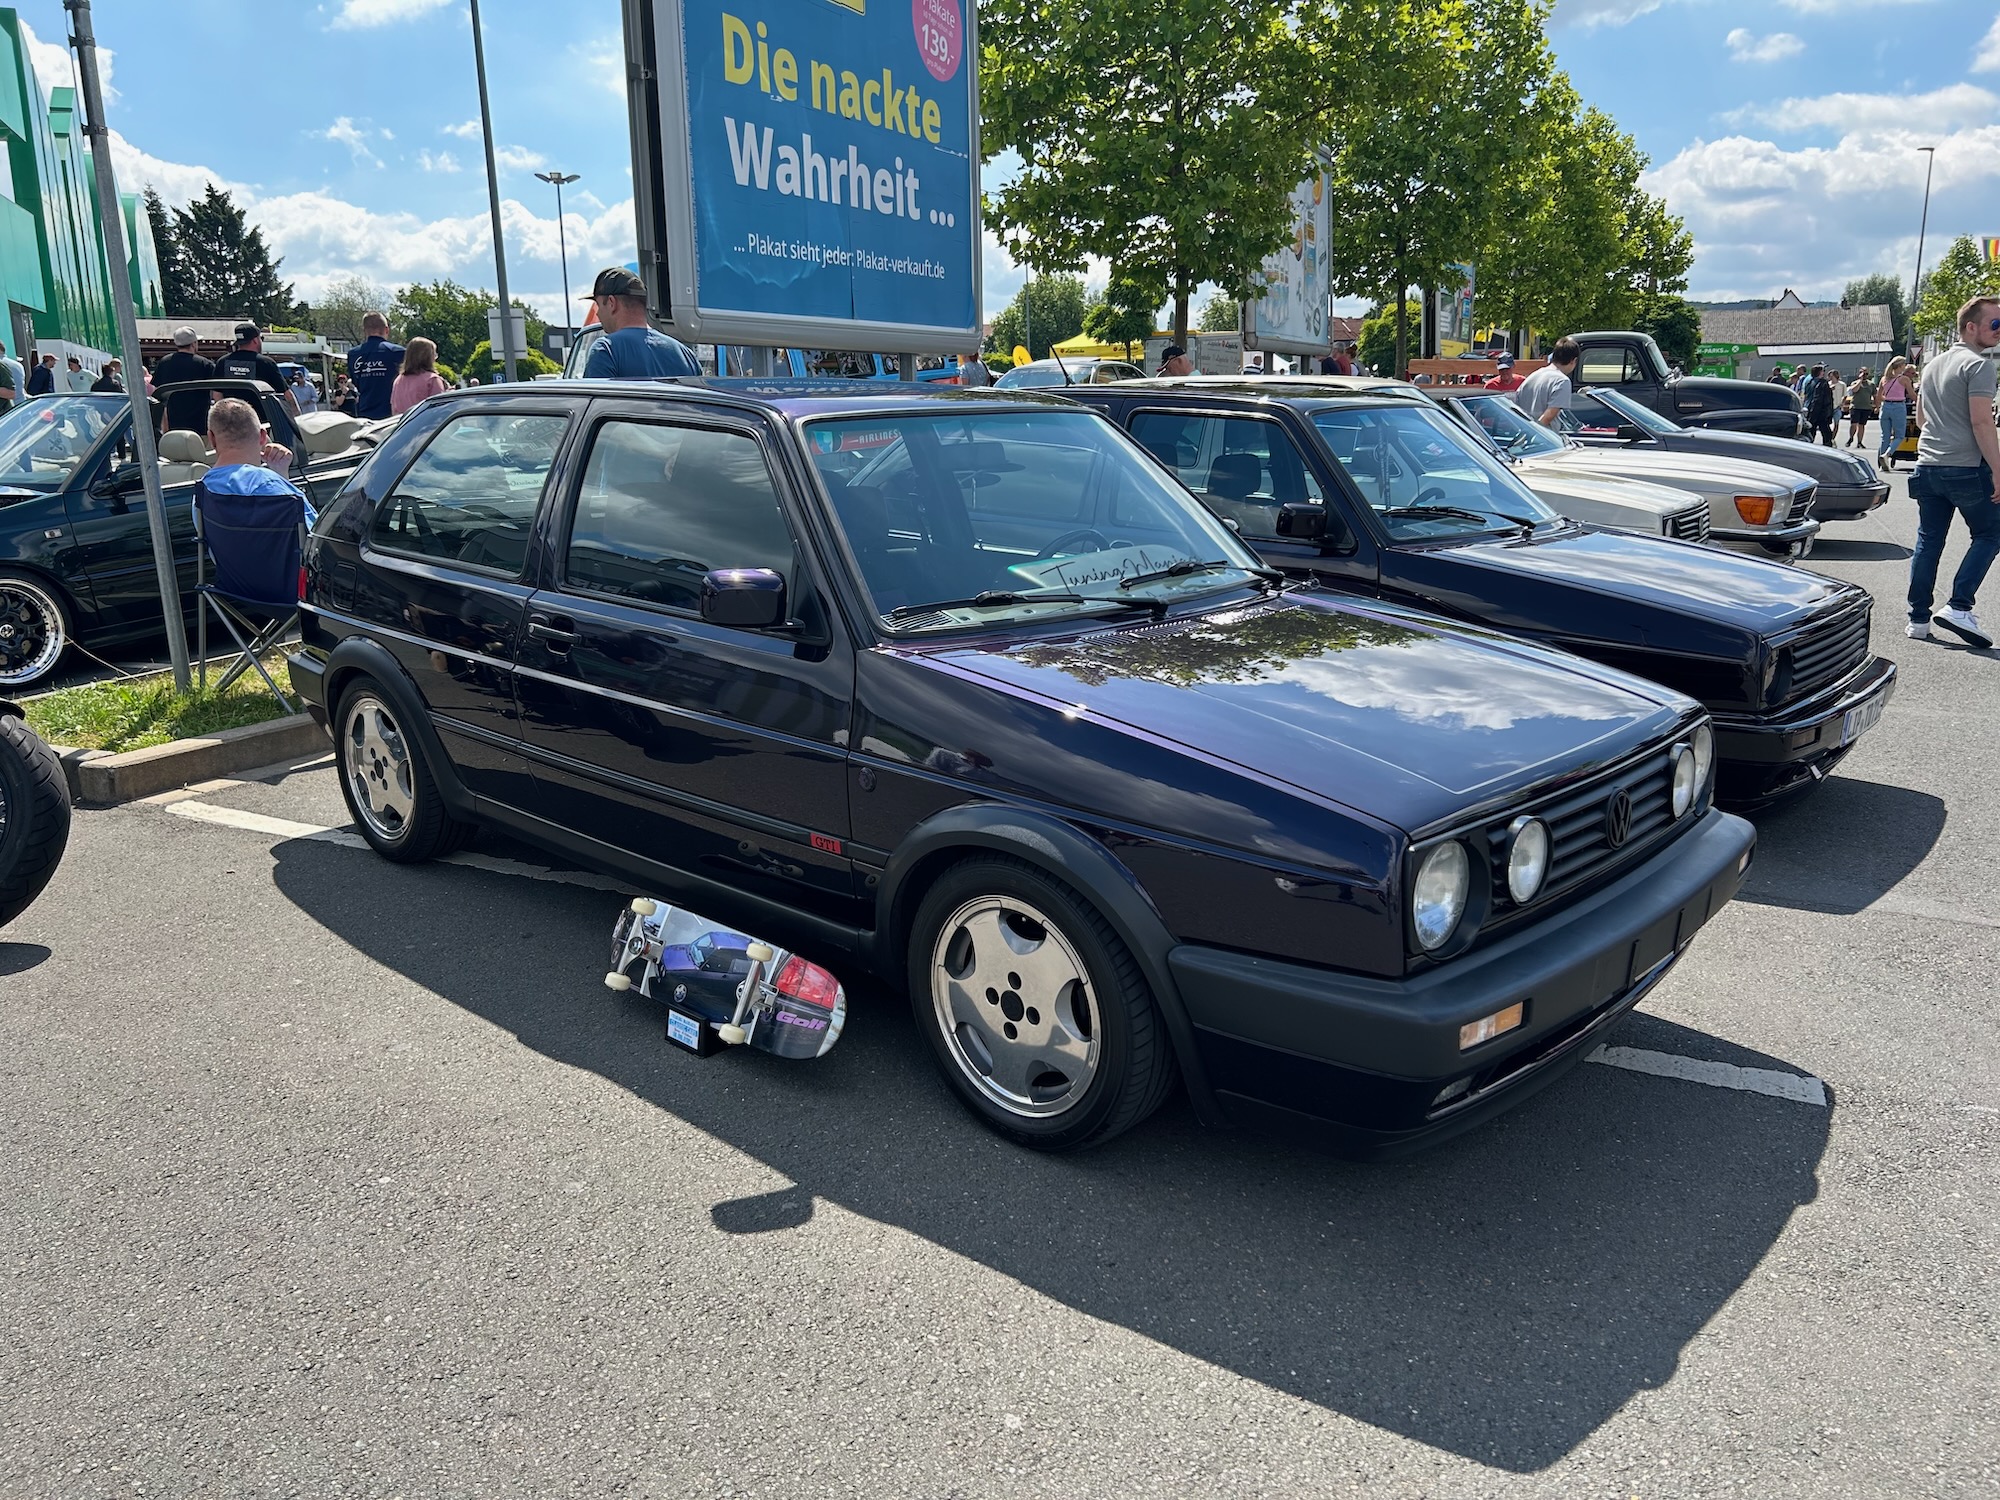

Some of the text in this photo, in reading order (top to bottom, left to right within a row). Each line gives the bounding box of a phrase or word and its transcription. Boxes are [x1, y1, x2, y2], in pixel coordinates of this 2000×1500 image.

[922, 24, 954, 65] 139,-
[722, 12, 941, 144] Die nackte
[724, 116, 920, 221] Wahrheit
[748, 233, 787, 258] Plakat
[790, 238, 820, 262] sieht
[821, 244, 854, 269] jeder:
[857, 249, 945, 279] Plakat-verkauft.de
[859, 428, 898, 444] AIRLINES
[815, 836, 836, 851] GTI
[776, 1010, 828, 1031] Golf
